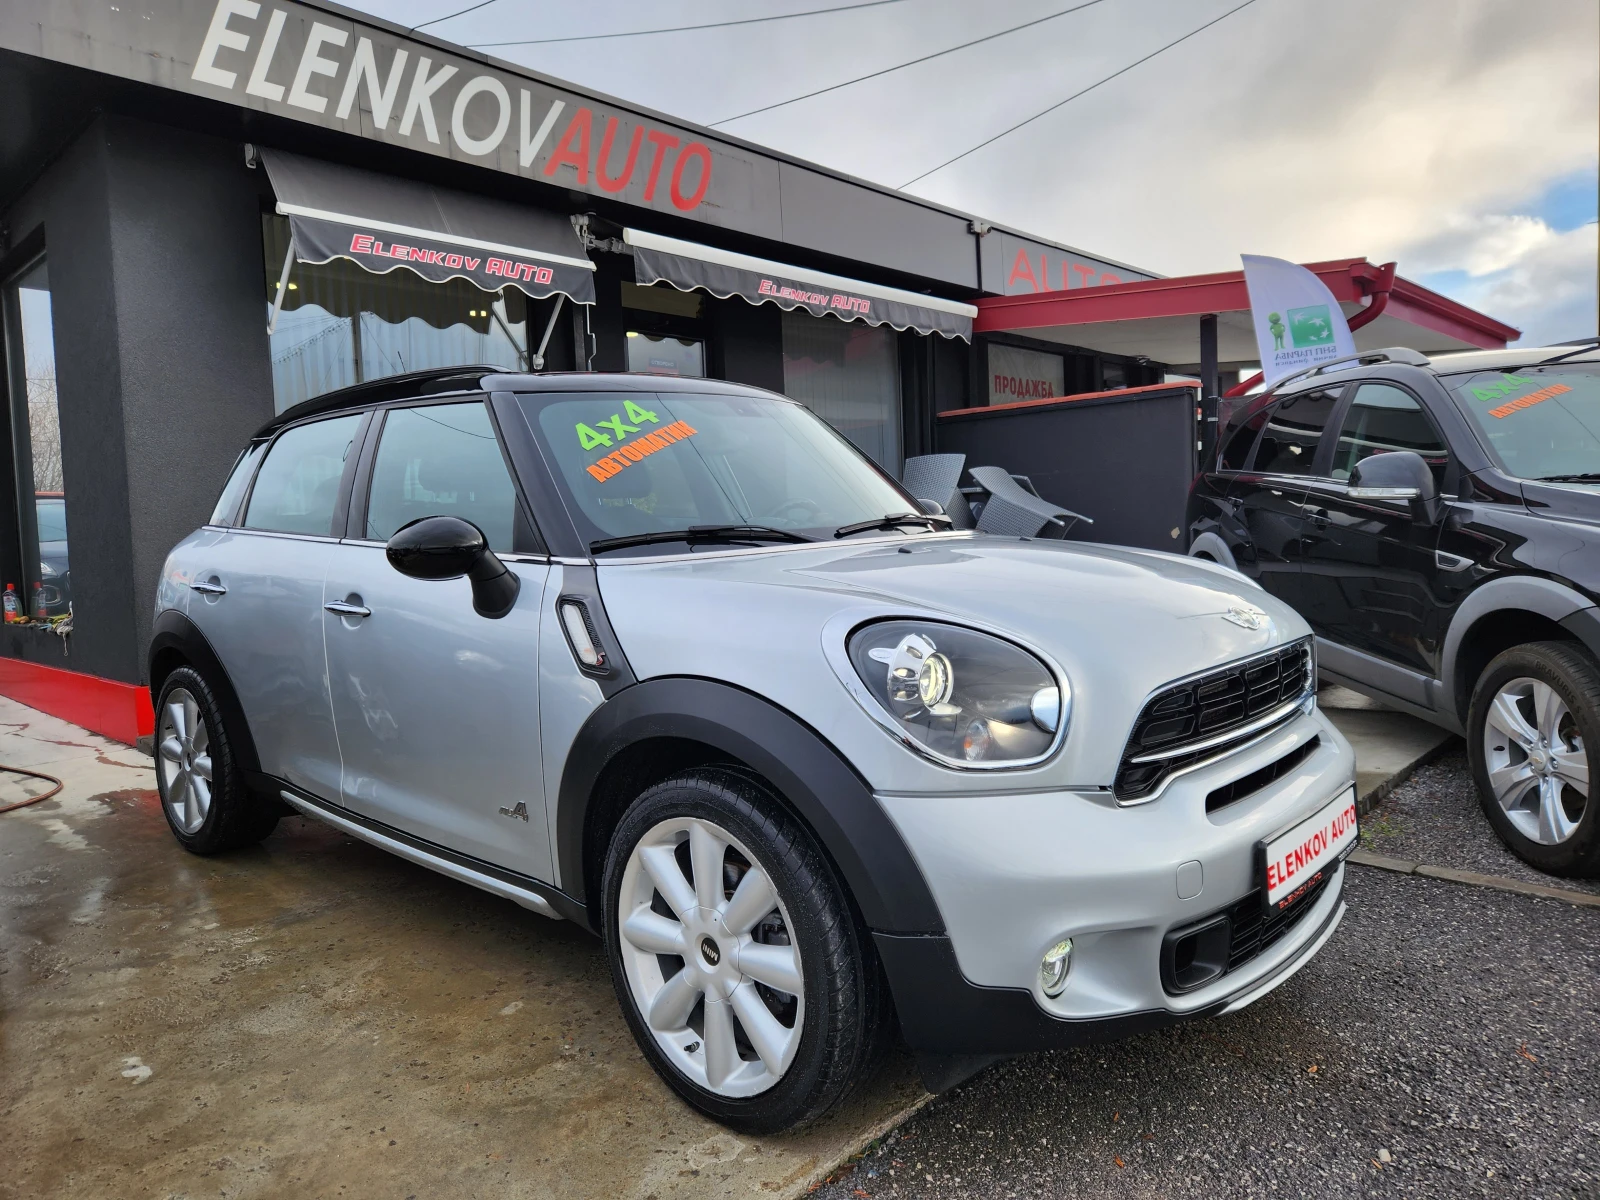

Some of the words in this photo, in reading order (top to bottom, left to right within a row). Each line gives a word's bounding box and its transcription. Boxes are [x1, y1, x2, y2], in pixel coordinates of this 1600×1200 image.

[485, 257, 554, 284] AUTO
[1008, 248, 1122, 293] AUT
[831, 294, 870, 313] AUTO
[994, 375, 1054, 398] ПРОДАЖБА
[1535, 661, 1578, 705] BRAVURIS
[1267, 826, 1328, 891] ELENKOV
[1332, 804, 1357, 843] AUTO
[1307, 871, 1323, 888] AUTO
[703, 943, 719, 961] MINI
